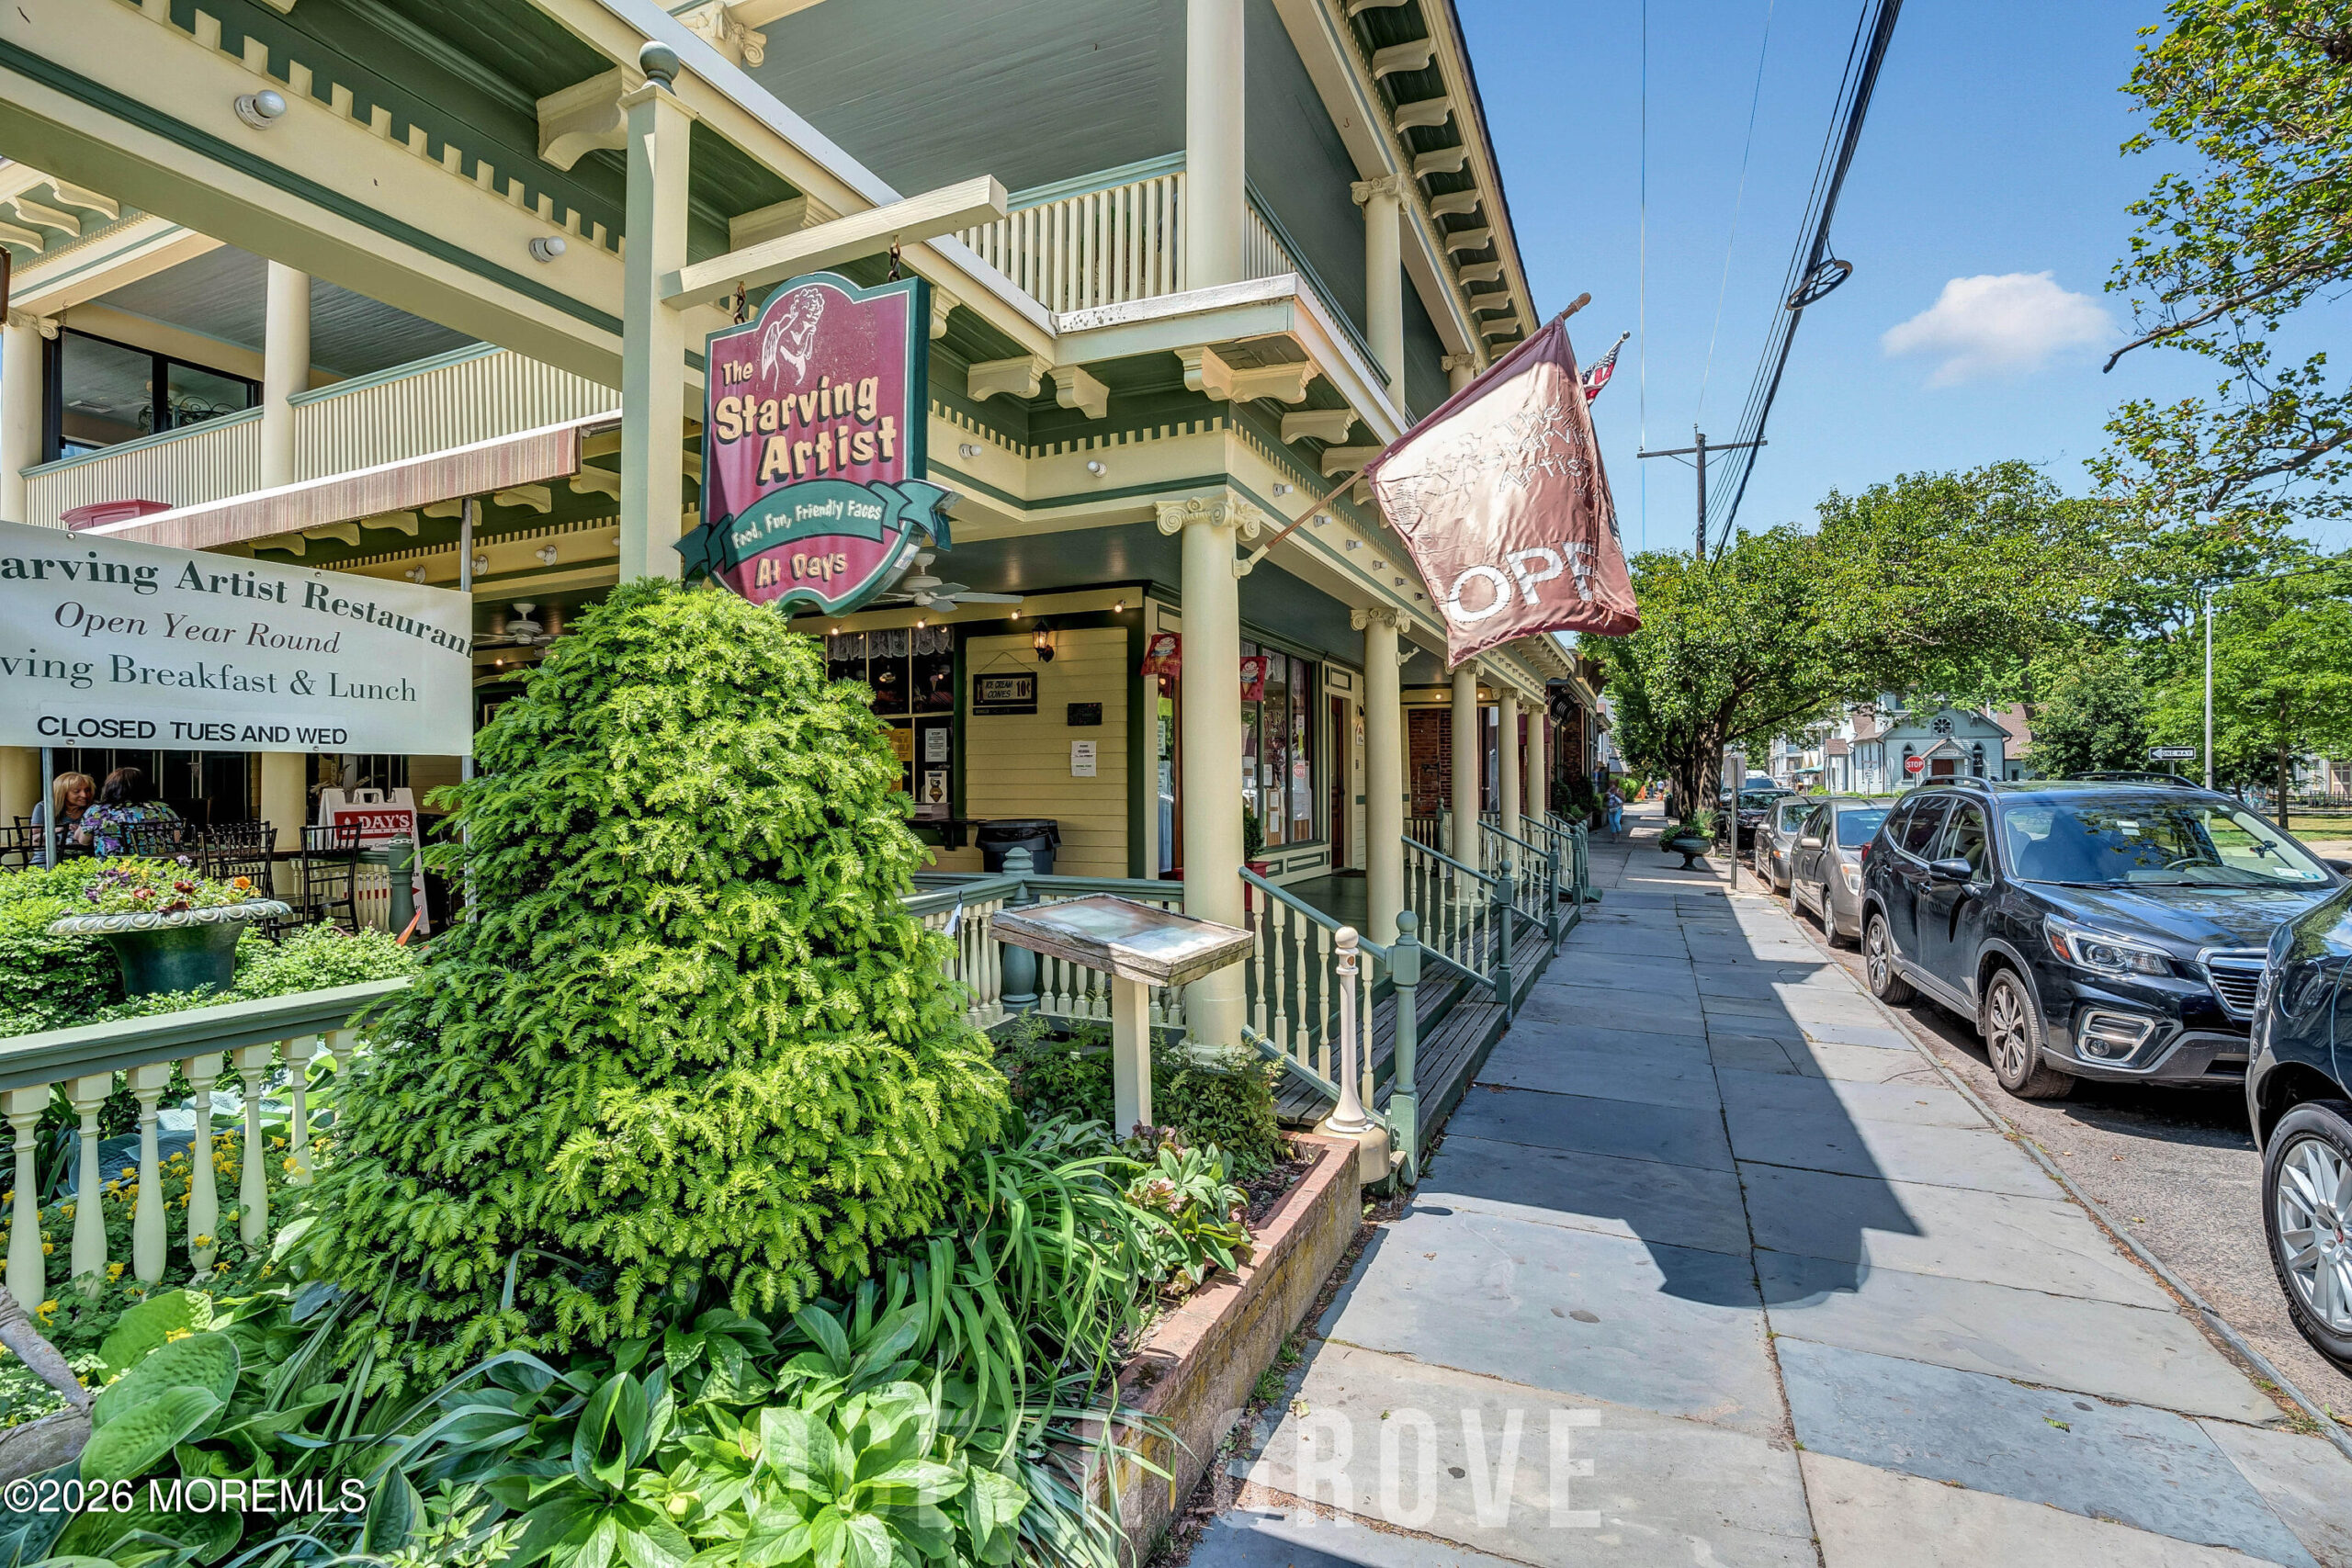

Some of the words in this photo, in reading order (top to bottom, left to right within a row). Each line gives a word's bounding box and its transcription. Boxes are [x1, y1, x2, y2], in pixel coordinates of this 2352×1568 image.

[722, 359, 753, 387] The
[715, 376, 879, 446] Starving
[755, 415, 898, 487] Artist
[731, 521, 763, 548] Food,
[764, 513, 792, 535] Fun,
[796, 499, 844, 523] Friendly
[847, 500, 883, 520] Faces
[755, 558, 780, 588] At
[791, 553, 848, 581] Days
[55, 601, 148, 637] Open
[163, 612, 237, 644] Year
[246, 622, 341, 654] Round
[174, 559, 288, 604] Artist
[301, 581, 472, 659] Restaurant
[108, 653, 278, 695] Breakfast
[289, 670, 316, 696] &
[328, 672, 418, 703] Lunch
[37, 716, 156, 739] CLOSED
[169, 721, 236, 741] TUES
[241, 725, 291, 743] AND
[296, 728, 348, 745] WED
[358, 814, 411, 829] DAY'S
